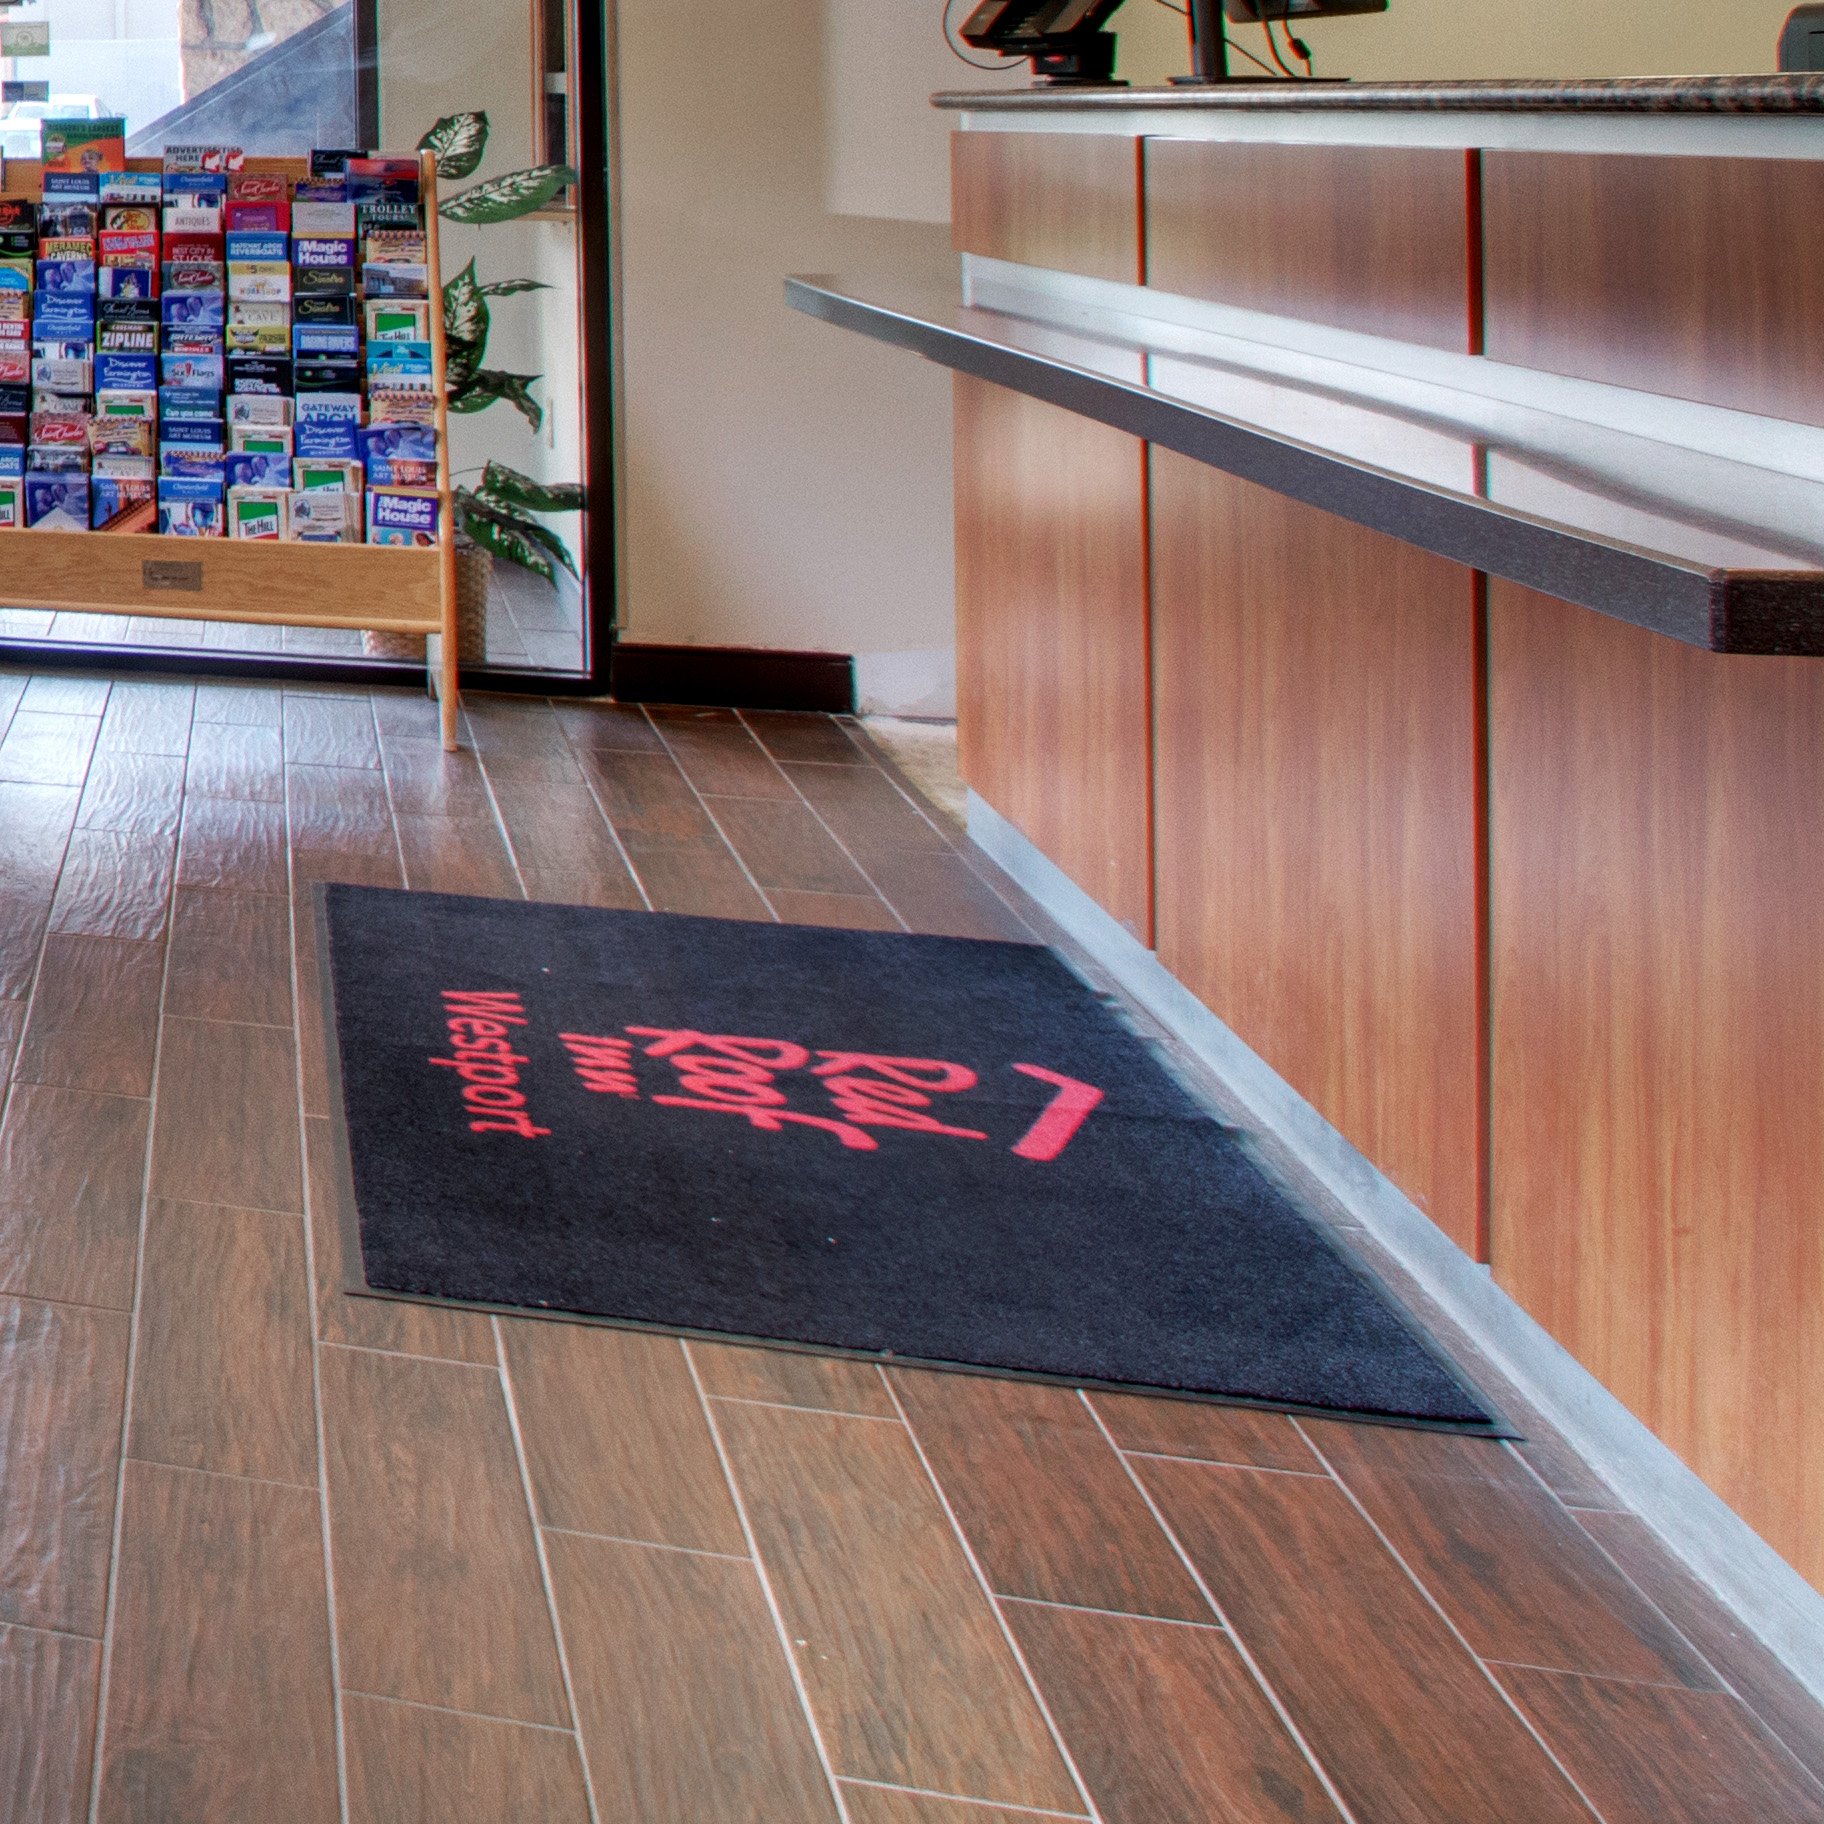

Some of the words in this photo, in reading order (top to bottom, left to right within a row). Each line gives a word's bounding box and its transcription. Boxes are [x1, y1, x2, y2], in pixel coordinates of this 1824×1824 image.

[361, 204, 417, 214] TROLLEY
[303, 240, 348, 254] Magic
[298, 252, 348, 265] House
[102, 331, 154, 348] ZIPLINE
[302, 403, 357, 413] GATEWAY
[382, 495, 432, 513] Magic
[377, 509, 431, 524] House
[428, 989, 552, 1139] Westport
[624, 1025, 880, 1152] Roof
[808, 1048, 989, 1142] Red
